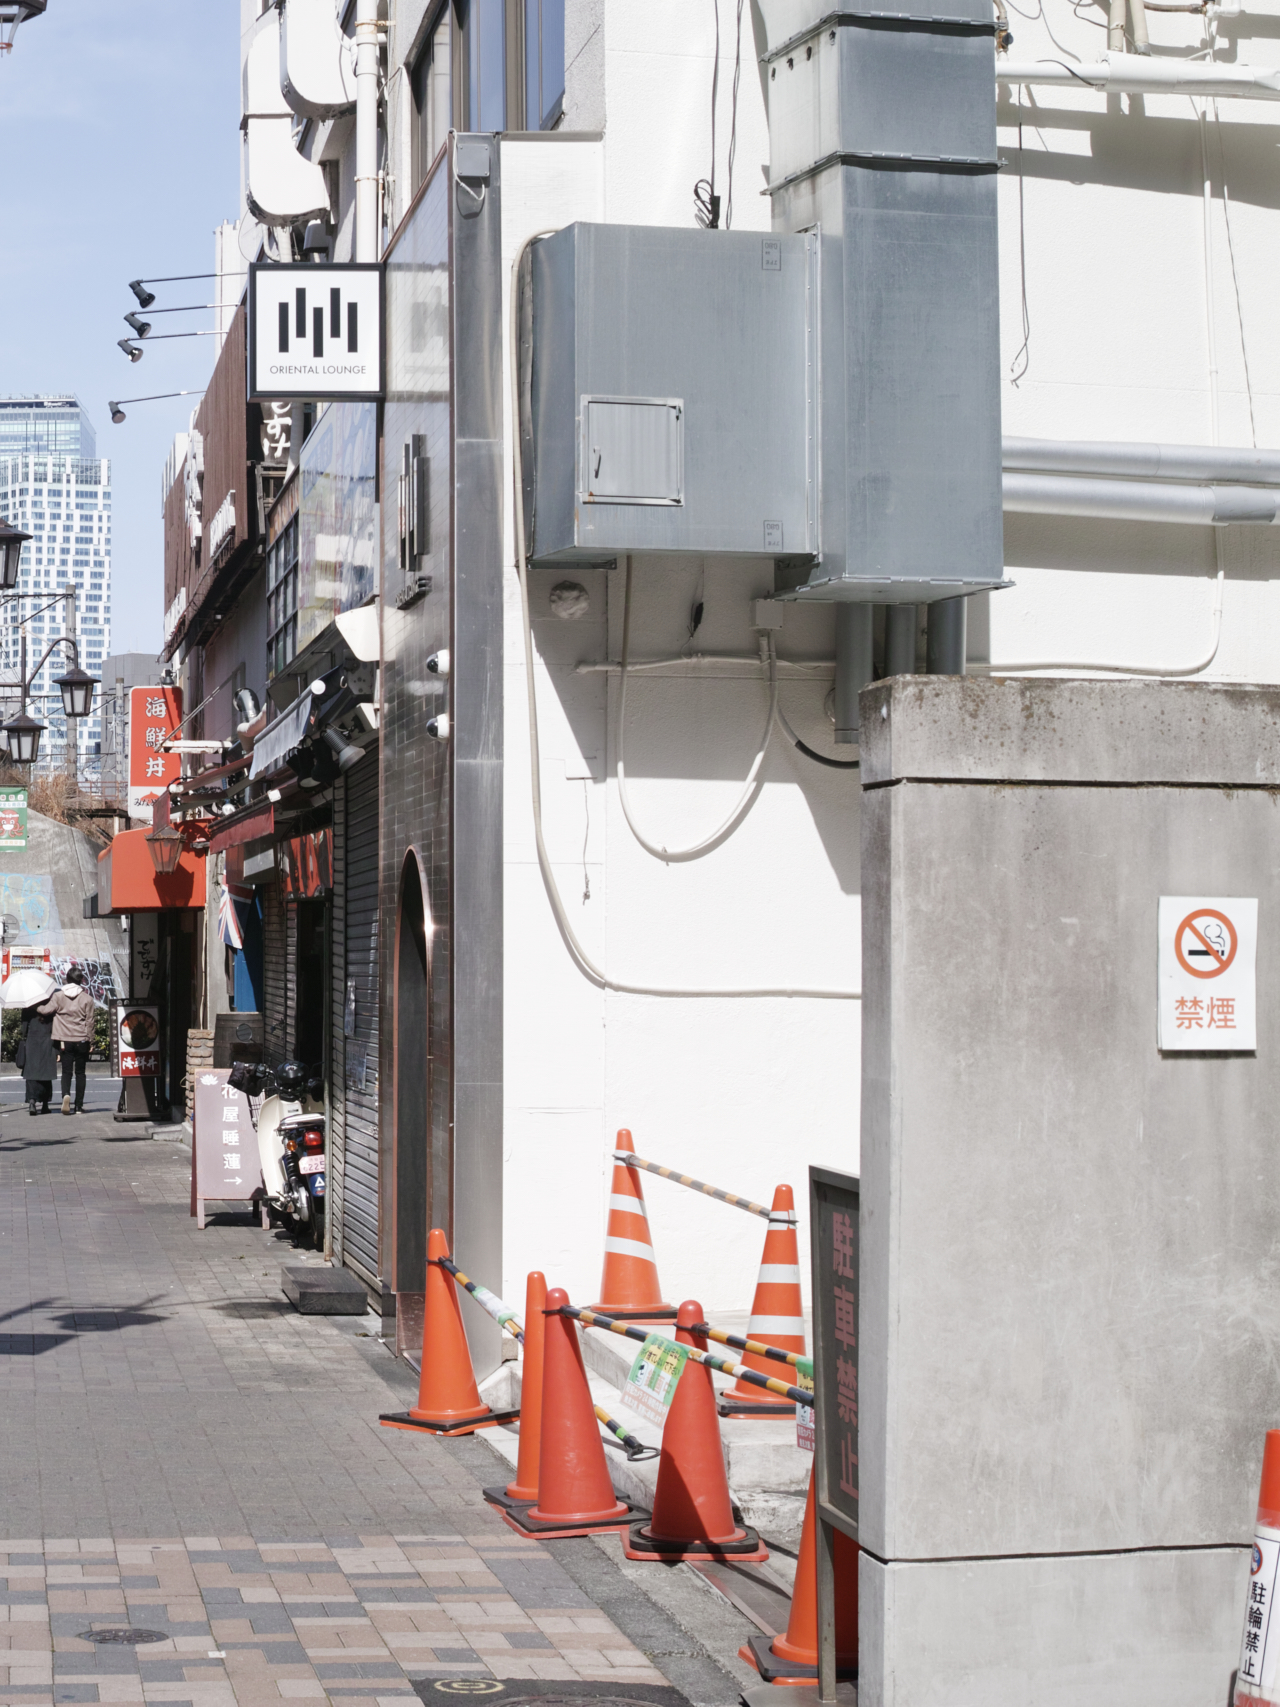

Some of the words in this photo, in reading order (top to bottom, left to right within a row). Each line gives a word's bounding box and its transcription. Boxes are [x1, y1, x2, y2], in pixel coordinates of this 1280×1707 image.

[269, 365, 320, 375] ORIENTAL
[322, 365, 367, 375] LOUNGE
[145, 696, 167, 778] 海鮮丼
[1175, 996, 1237, 1030] 禁煙
[122, 1055, 158, 1072] 海鮮丼
[221, 1083, 241, 1170] 花屋睡蓮
[832, 1211, 859, 1500] 駐車禁止
[1242, 1580, 1267, 1678] 駐輪禁止
